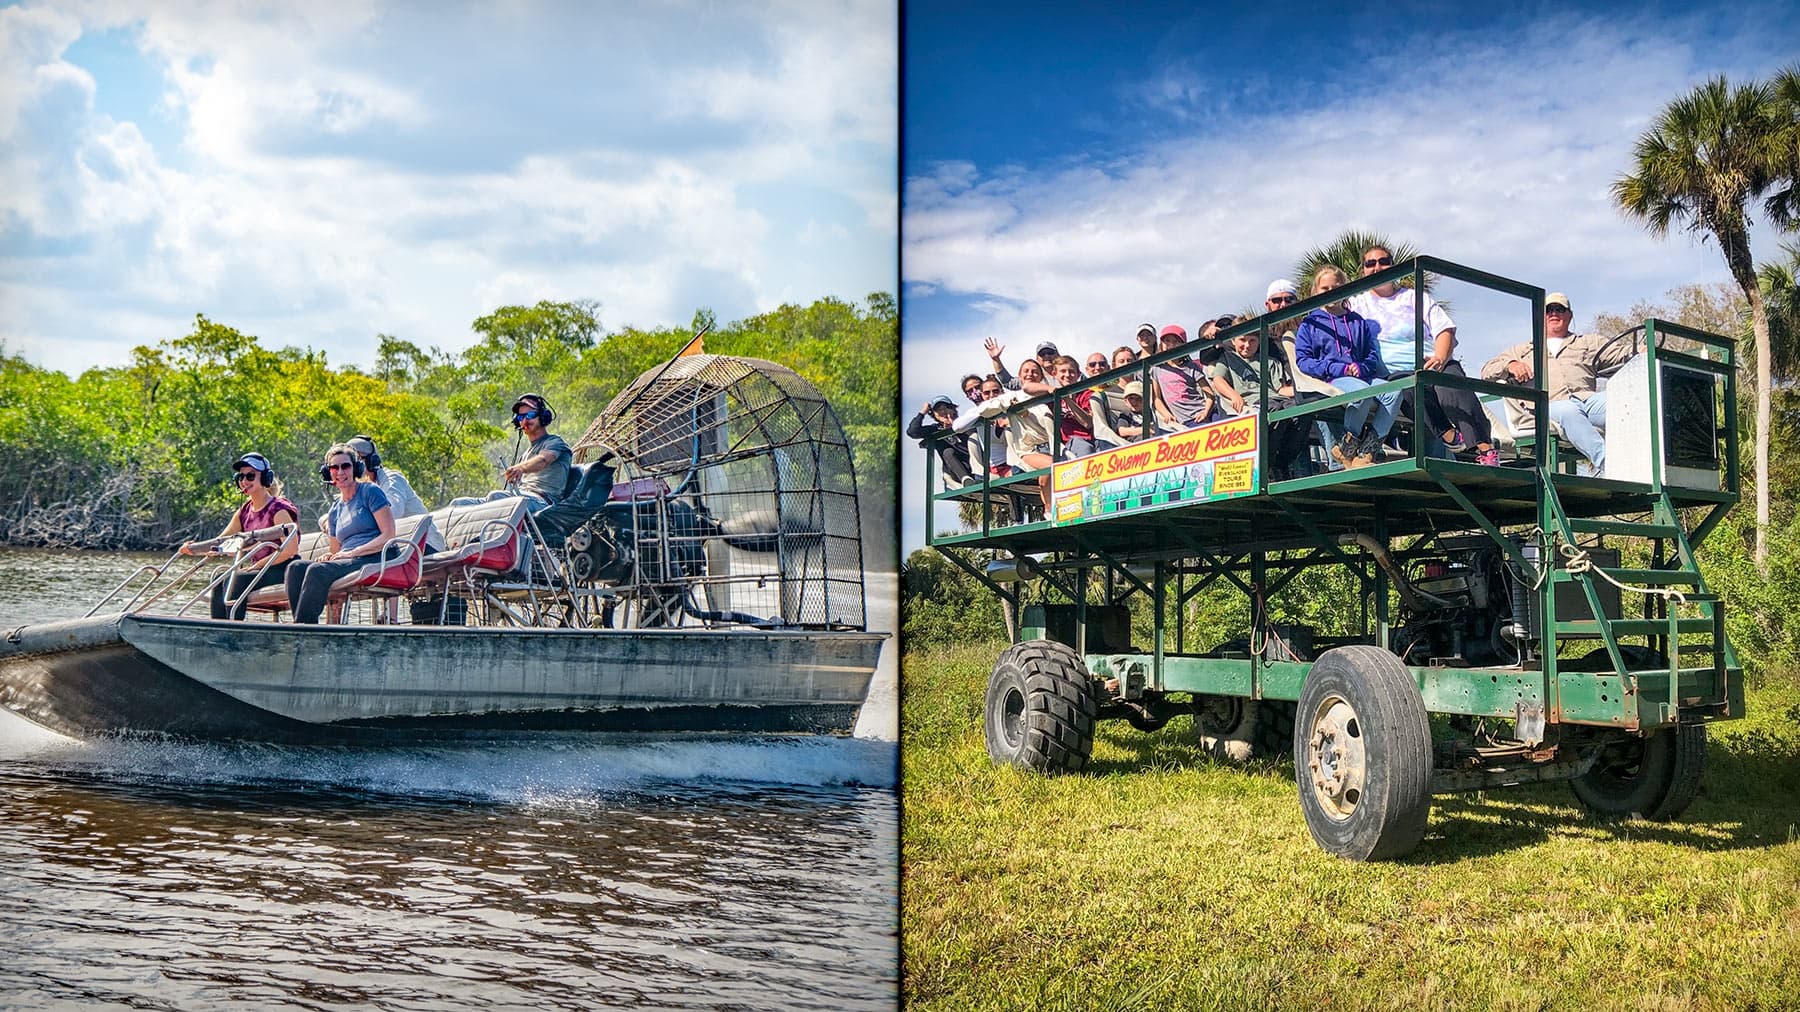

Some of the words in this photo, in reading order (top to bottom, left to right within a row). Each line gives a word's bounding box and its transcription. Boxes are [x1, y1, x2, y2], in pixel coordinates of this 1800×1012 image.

[1107, 451, 1151, 475] Swamp
[1156, 439, 1200, 464] Buggy
[1205, 426, 1250, 453] Rides
